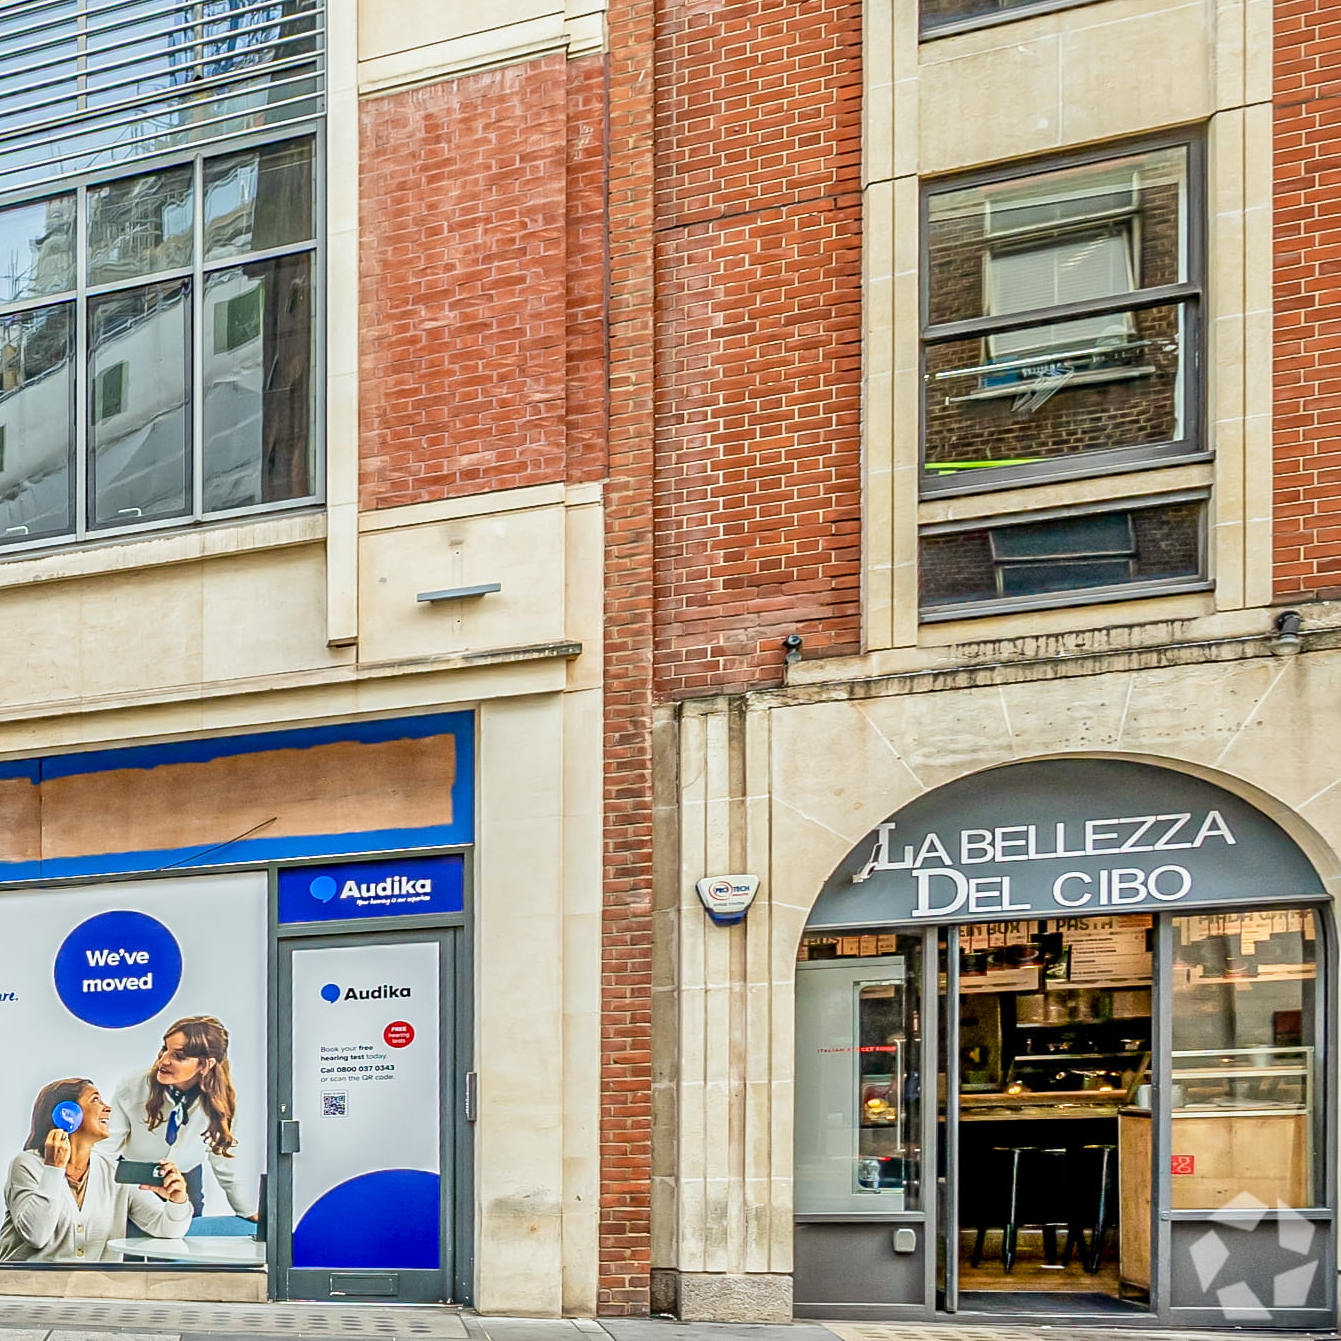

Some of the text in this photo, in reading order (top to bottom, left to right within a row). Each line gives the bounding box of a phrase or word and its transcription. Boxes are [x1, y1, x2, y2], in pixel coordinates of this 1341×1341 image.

[961, 810, 1236, 864] BELLEZZA
[340, 876, 432, 898] Audika
[912, 865, 1191, 917] DEL CIBO
[86, 948, 149, 966] We've
[83, 973, 152, 992] moved
[344, 985, 411, 1001] Audika
